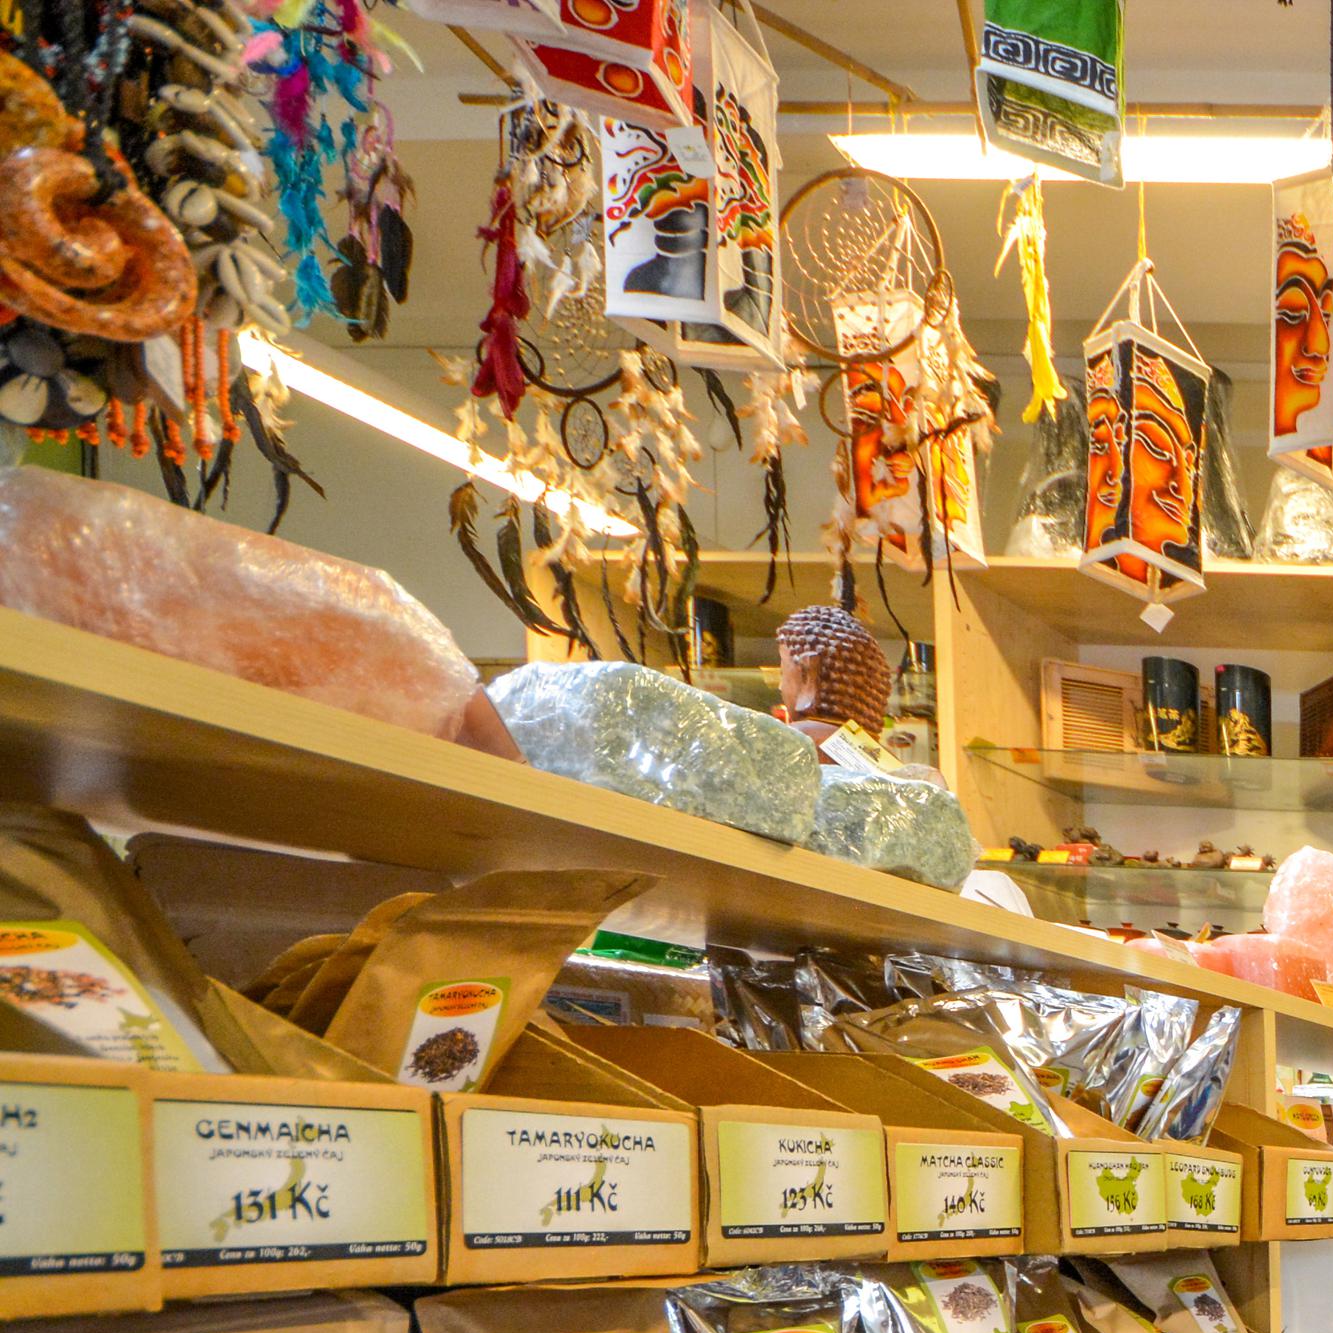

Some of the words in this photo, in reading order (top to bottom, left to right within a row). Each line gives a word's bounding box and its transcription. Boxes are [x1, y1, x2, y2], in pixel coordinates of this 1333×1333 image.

[195, 1118, 352, 1144] GENMAICHA
[506, 1129, 656, 1152] TAMARYOKUCHA
[778, 1137, 833, 1156] KUKICHA
[920, 1155, 963, 1169] MATCHA
[965, 1154, 1004, 1170] CLASSIC
[231, 1186, 277, 1224] 131
[289, 1180, 331, 1221] Kč
[554, 1186, 581, 1212] 111
[590, 1179, 618, 1213] Kč
[812, 1182, 834, 1209] Kč
[943, 1195, 966, 1215] 140
[968, 1191, 986, 1214] Kč
[1122, 1191, 1138, 1211] Kč
